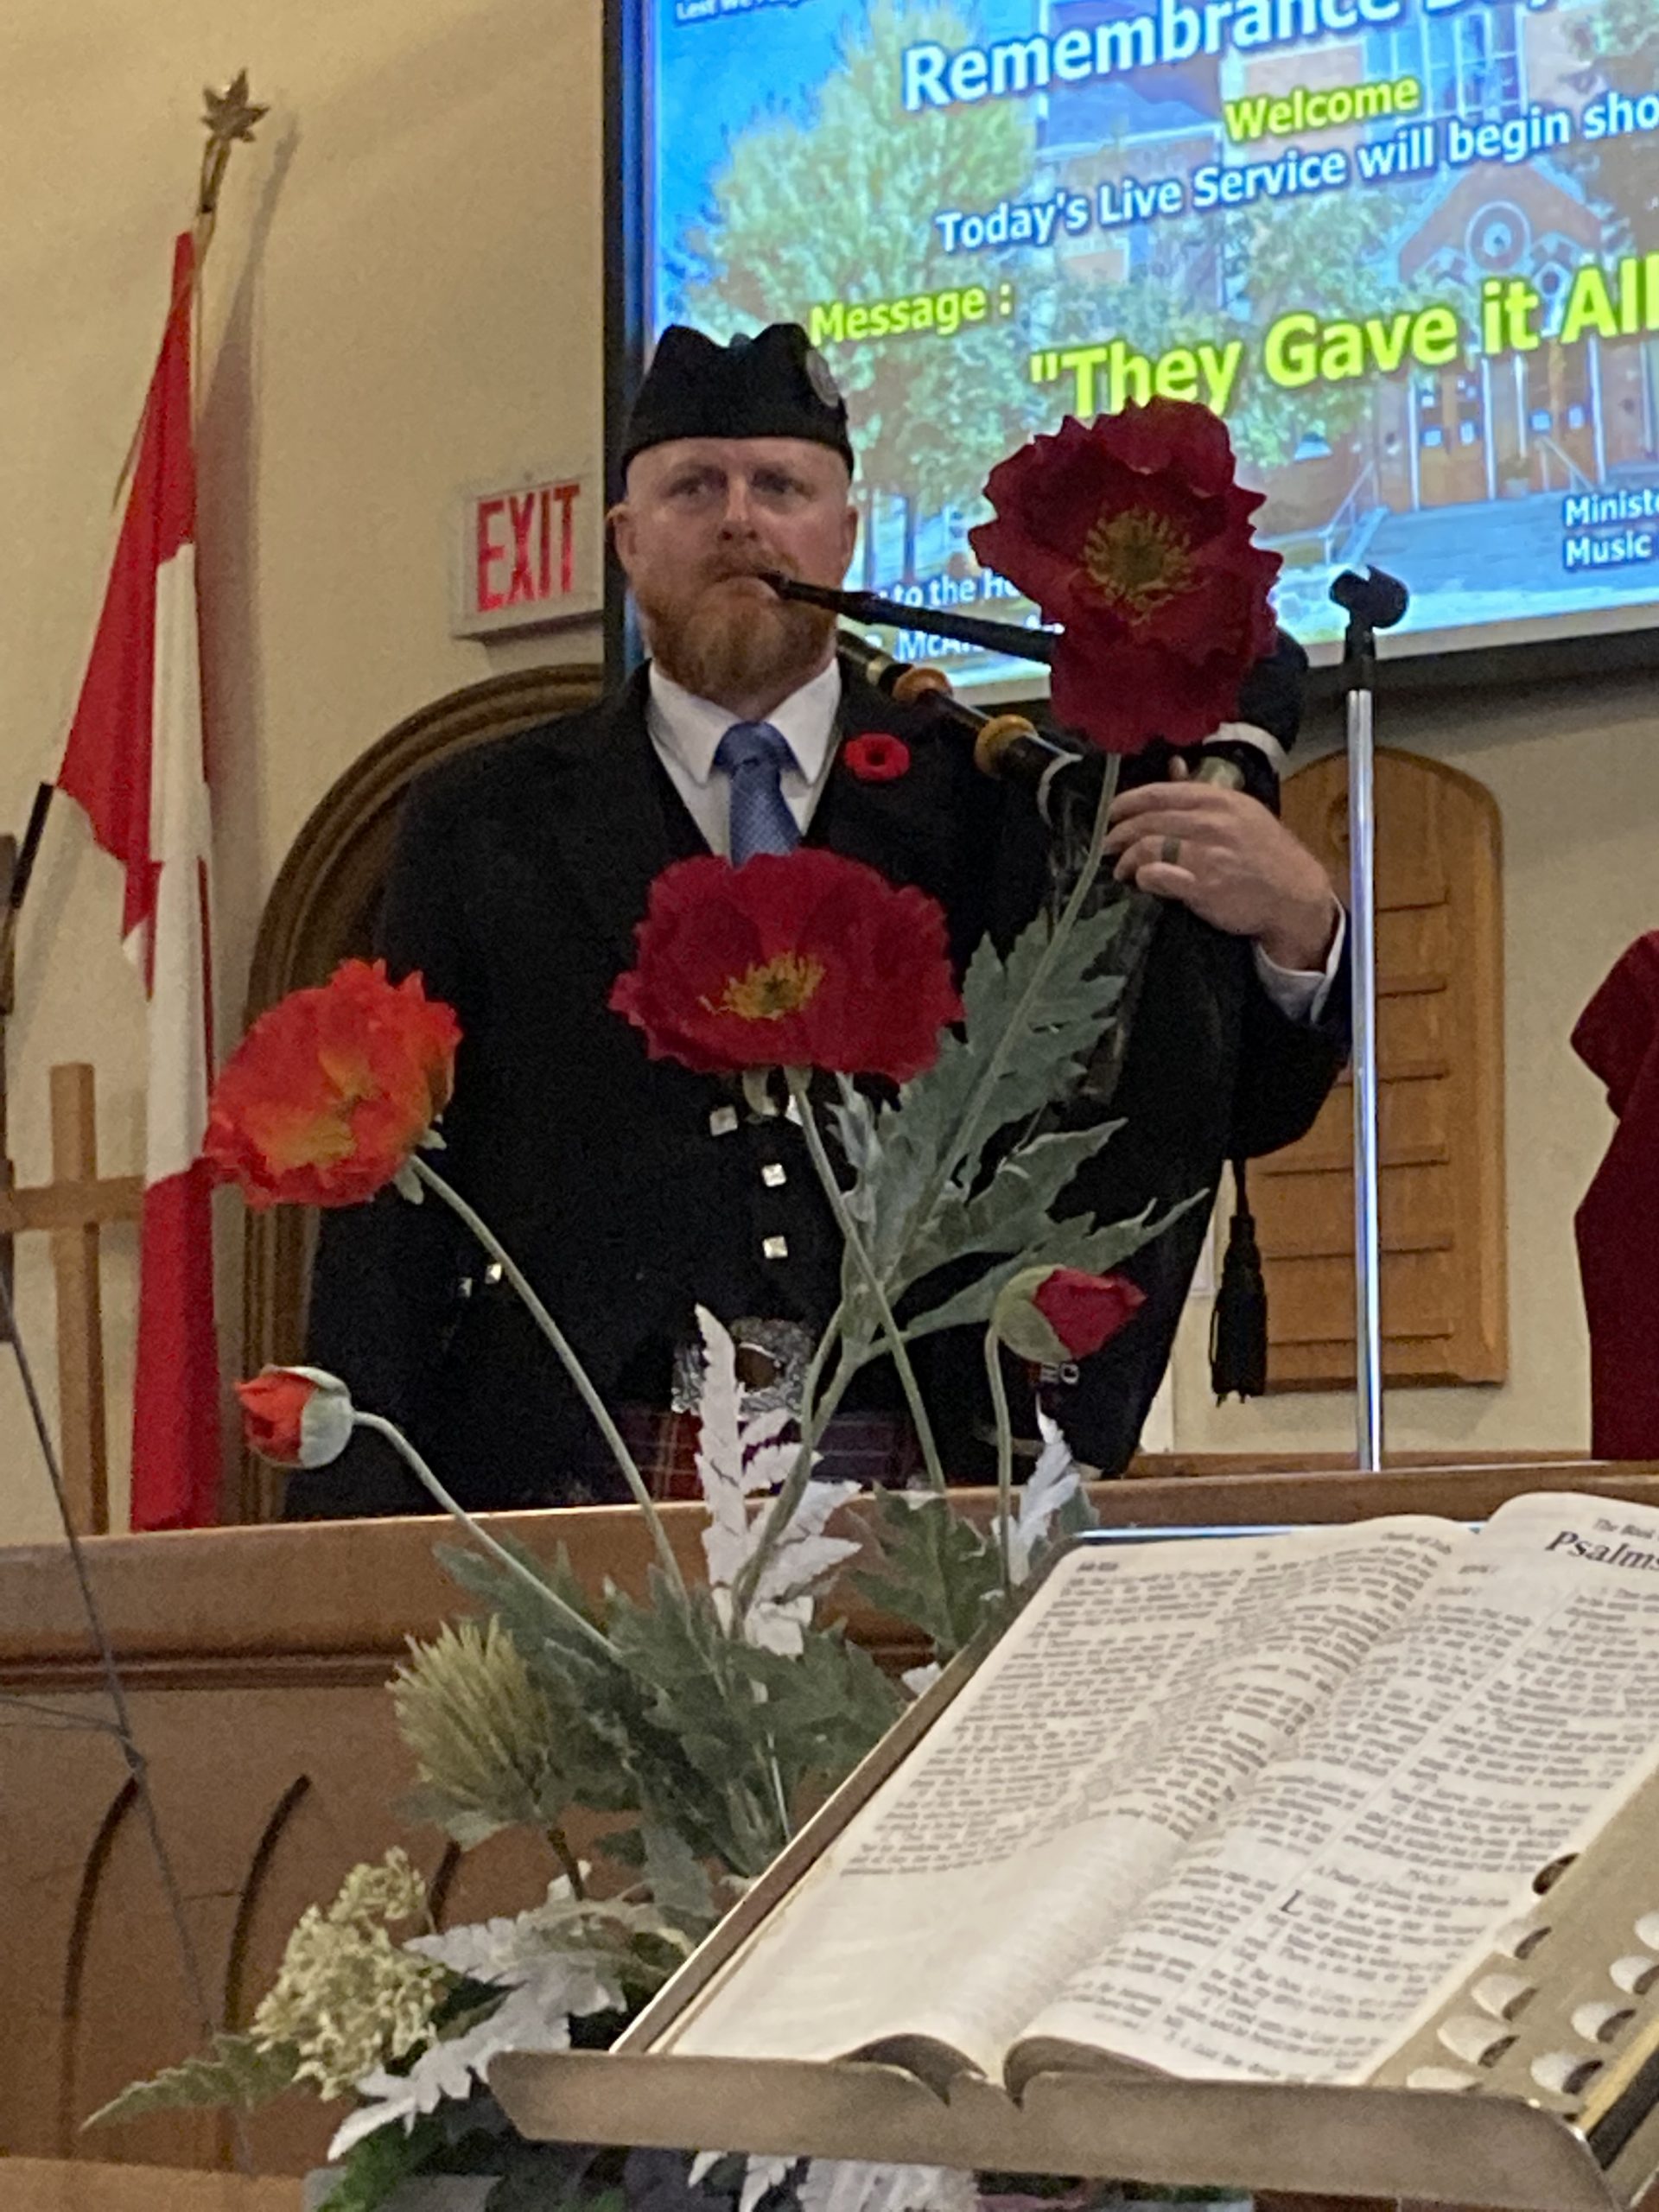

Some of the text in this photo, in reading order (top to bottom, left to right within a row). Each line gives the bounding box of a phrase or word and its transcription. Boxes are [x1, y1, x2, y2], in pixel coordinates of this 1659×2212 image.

[1224, 78, 1420, 141] Welcome
[935, 192, 1089, 252] Today's
[1099, 180, 1182, 225] Live
[1193, 149, 1347, 207] Service
[1357, 124, 1434, 179] will
[1449, 105, 1570, 162] begin
[810, 287, 987, 346] Message
[1030, 253, 1659, 418] "They Gave it All
[478, 484, 581, 613] EXIT
[1565, 529, 1652, 567] Music
[930, 574, 976, 606] the
